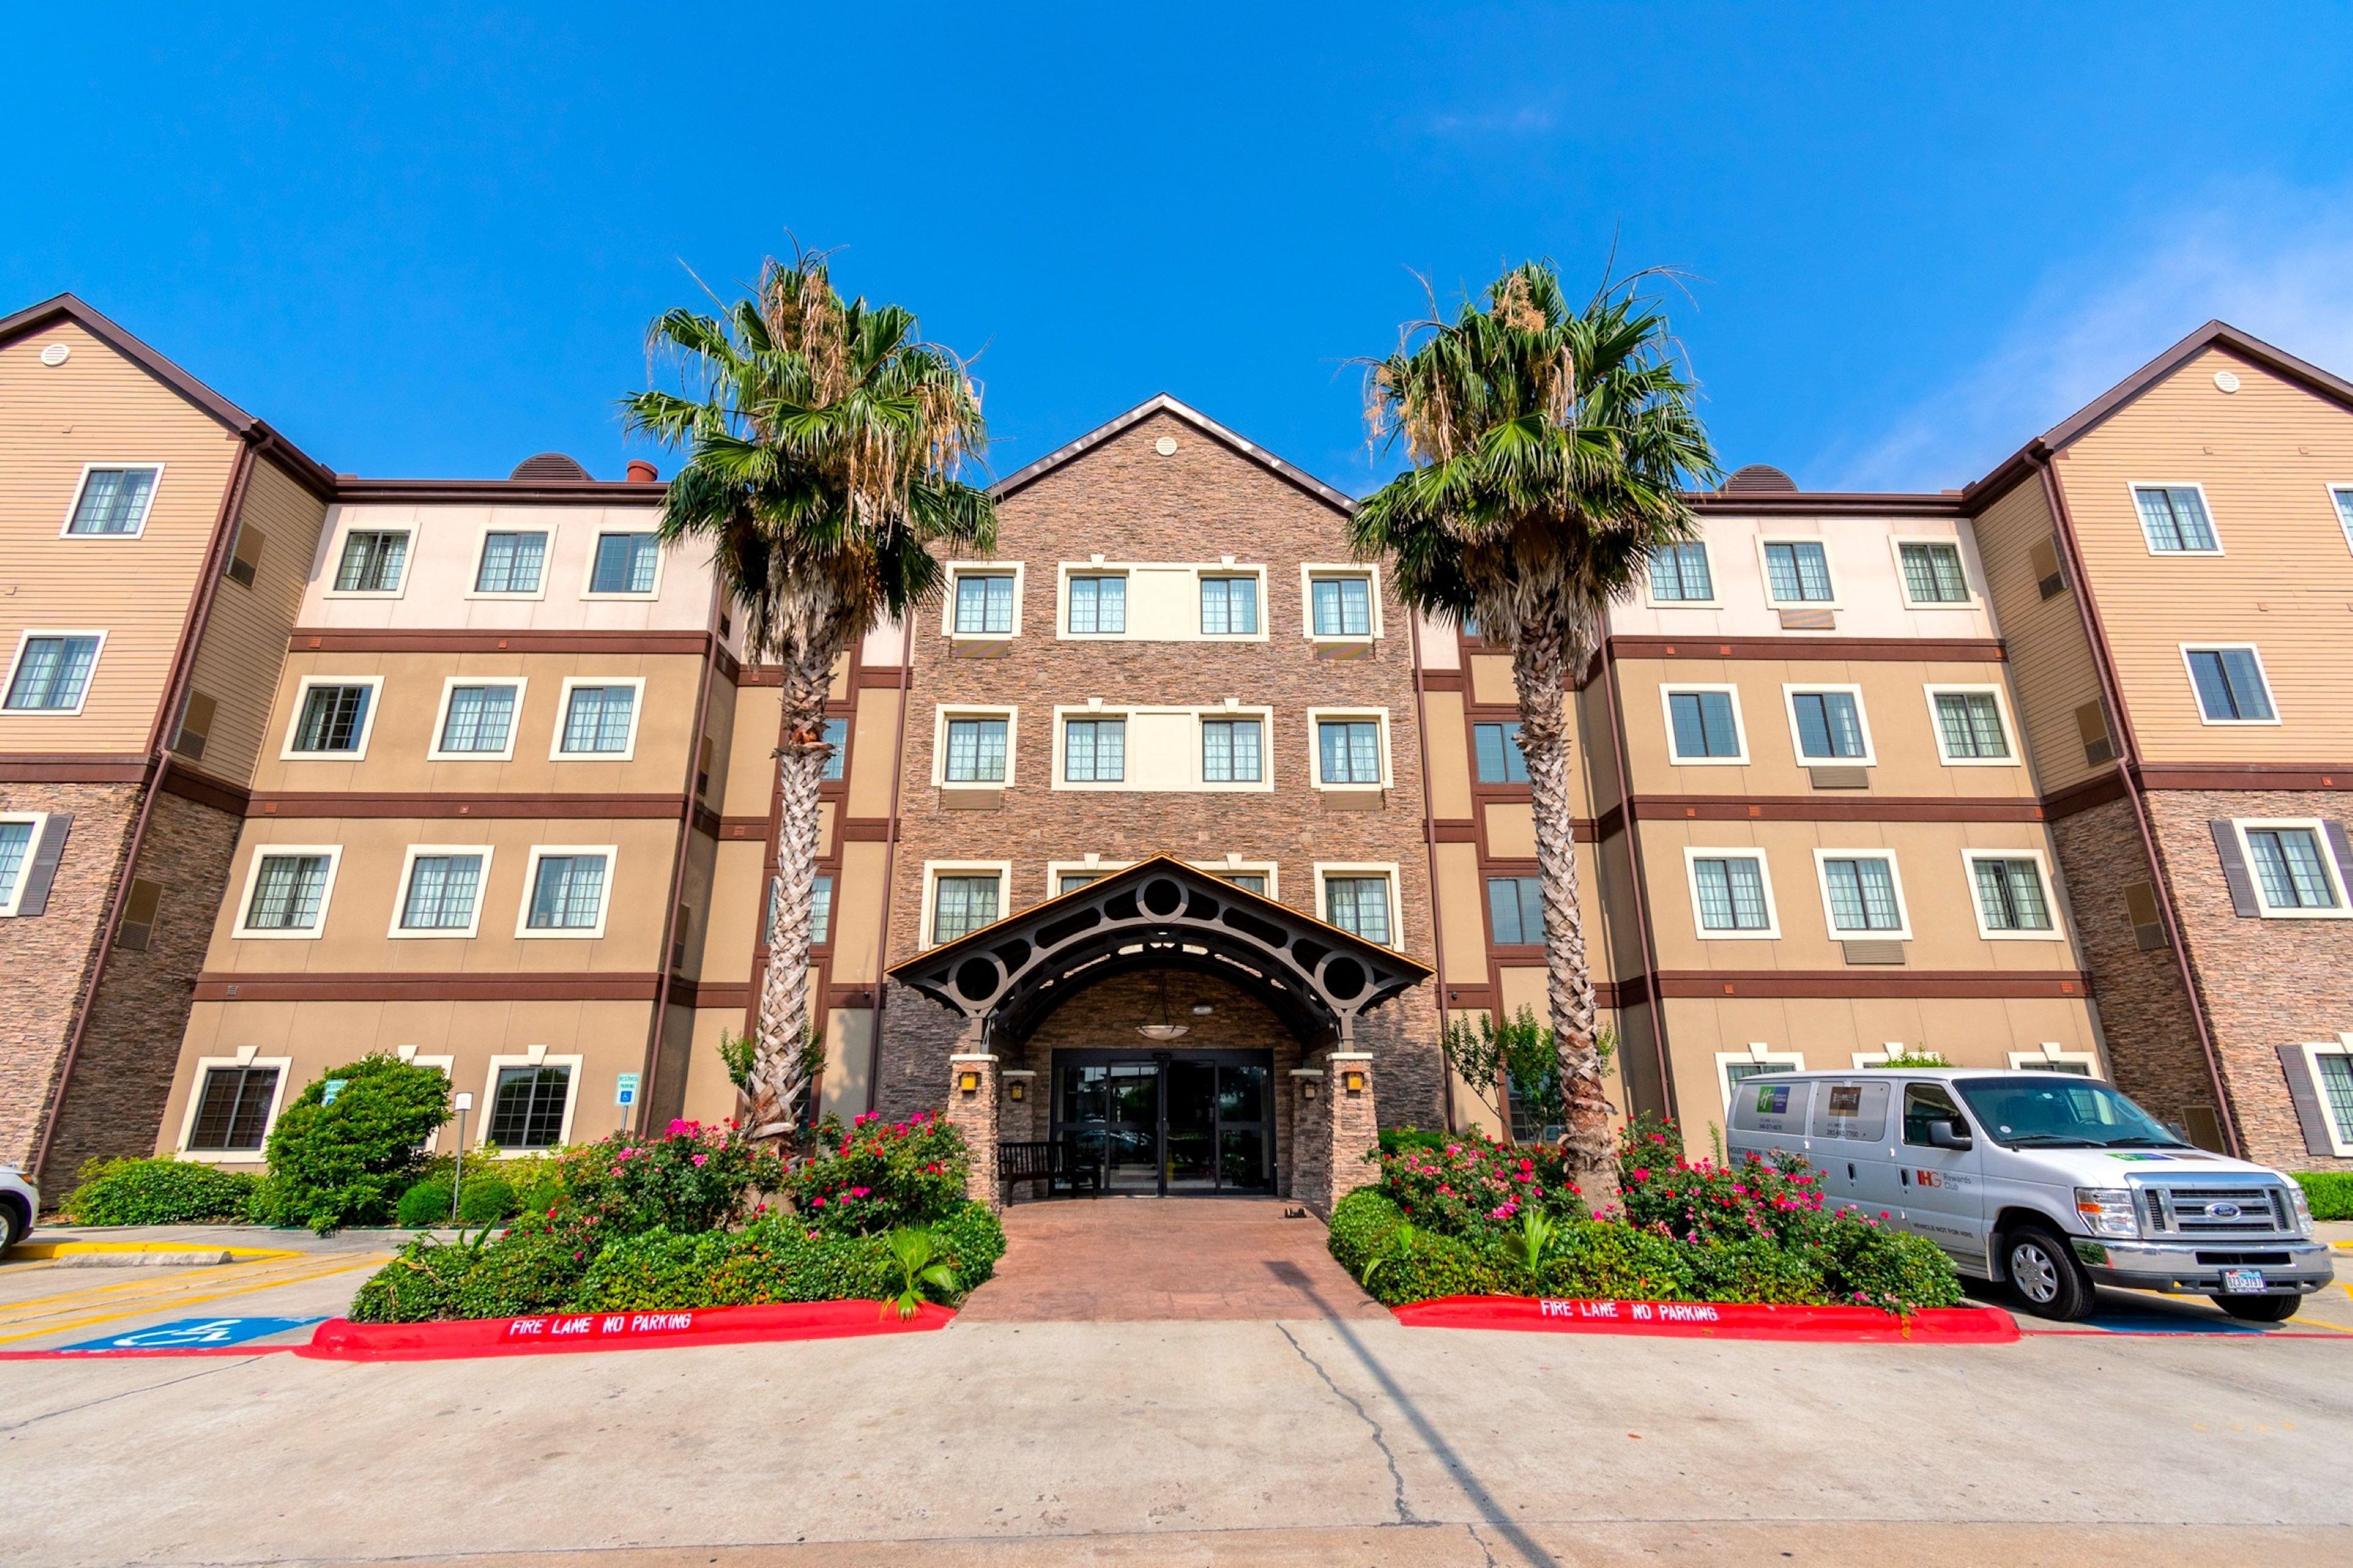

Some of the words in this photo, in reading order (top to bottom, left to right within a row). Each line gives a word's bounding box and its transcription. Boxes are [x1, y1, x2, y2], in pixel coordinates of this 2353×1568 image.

[1917, 1169, 1942, 1188] IHG
[1943, 1172, 1971, 1184] Rewards
[1945, 1182, 1959, 1191] Club
[1913, 1222, 1935, 1231] VEHICLE
[1540, 1300, 1573, 1317] FIRE
[1579, 1302, 1619, 1318] LANE
[1631, 1303, 1653, 1320] NO
[1659, 1304, 1718, 1321] PARKING
[510, 1319, 547, 1336] FIRE
[551, 1316, 594, 1335] LANE
[602, 1316, 625, 1333] NO
[631, 1313, 692, 1332] PARKING
